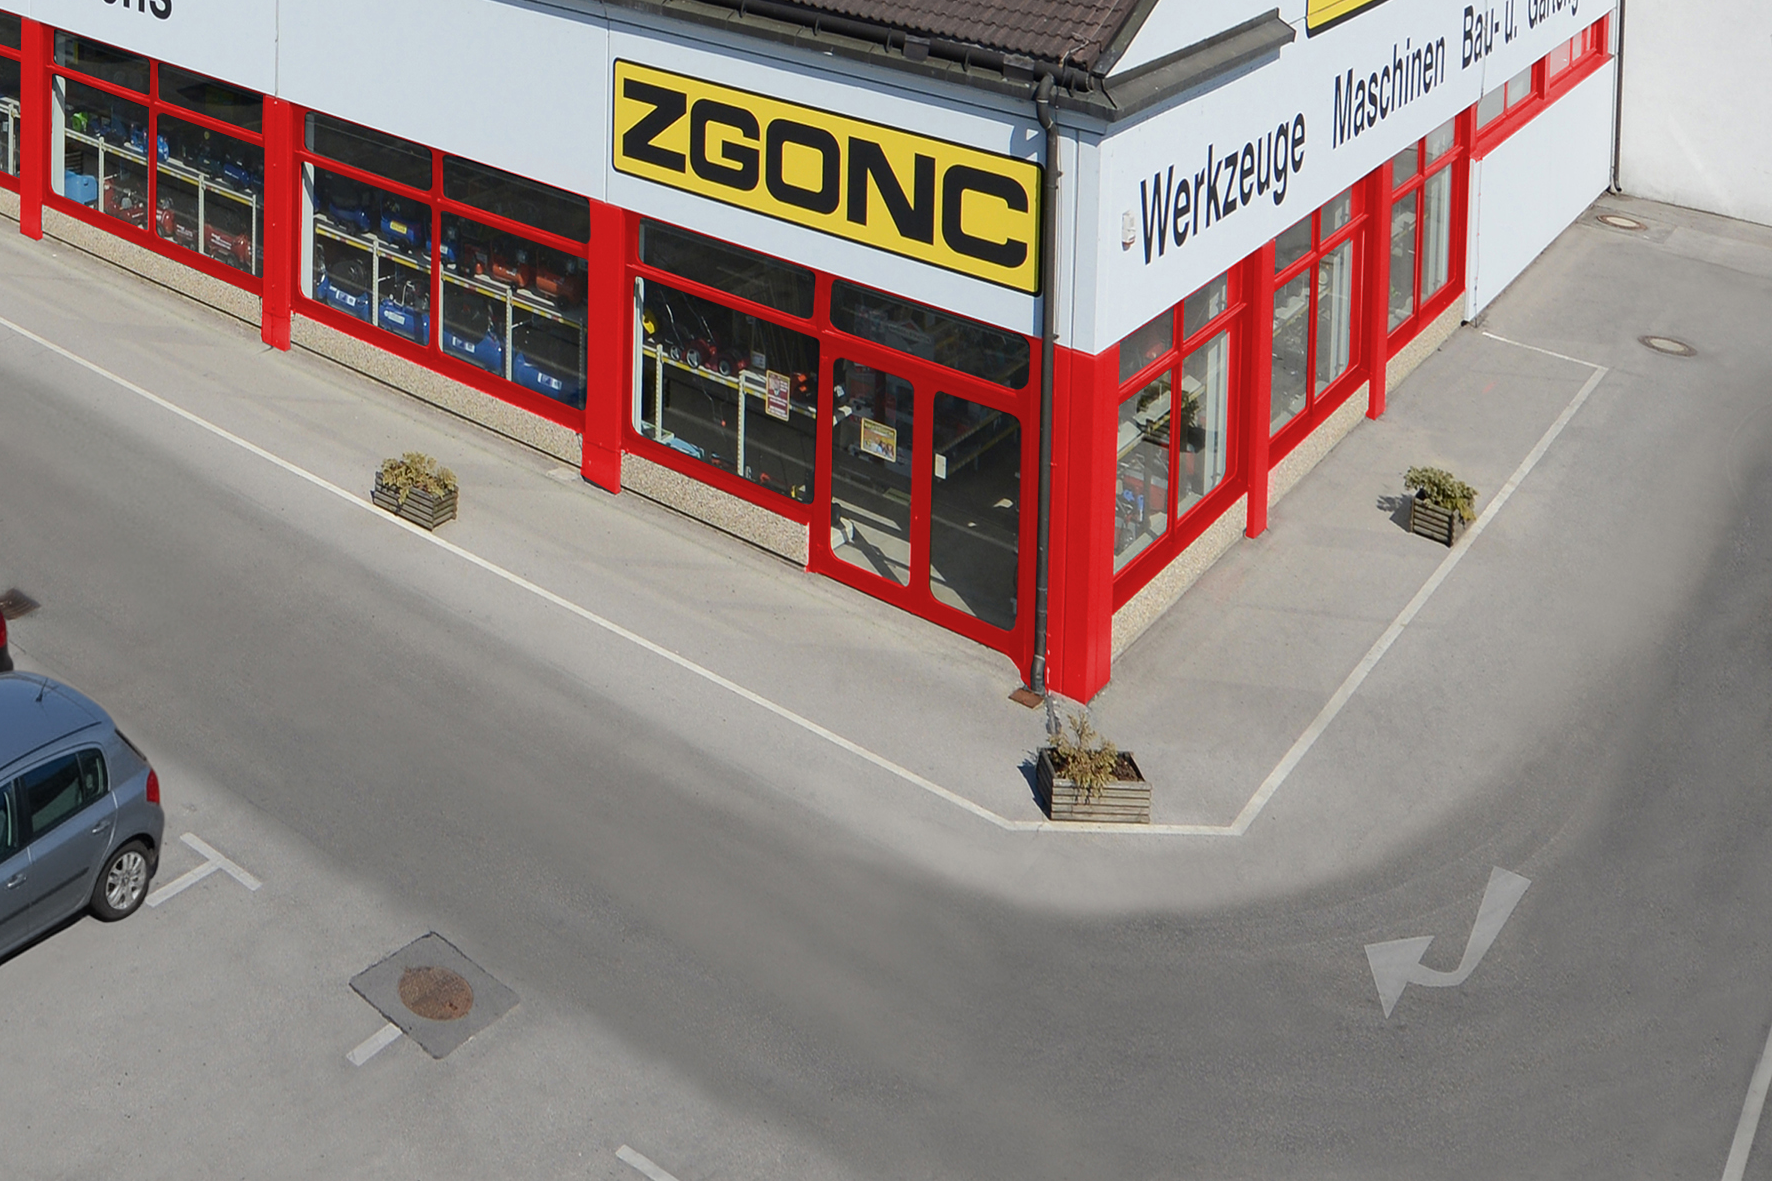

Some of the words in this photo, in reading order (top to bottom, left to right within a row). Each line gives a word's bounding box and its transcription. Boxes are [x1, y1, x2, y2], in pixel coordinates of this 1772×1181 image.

[622, 78, 1029, 269] ZGONC
[1139, 112, 1306, 265] Werkzeuge
[1332, 35, 1446, 150] Maschinen
[1461, 5, 1500, 70] Bau-
